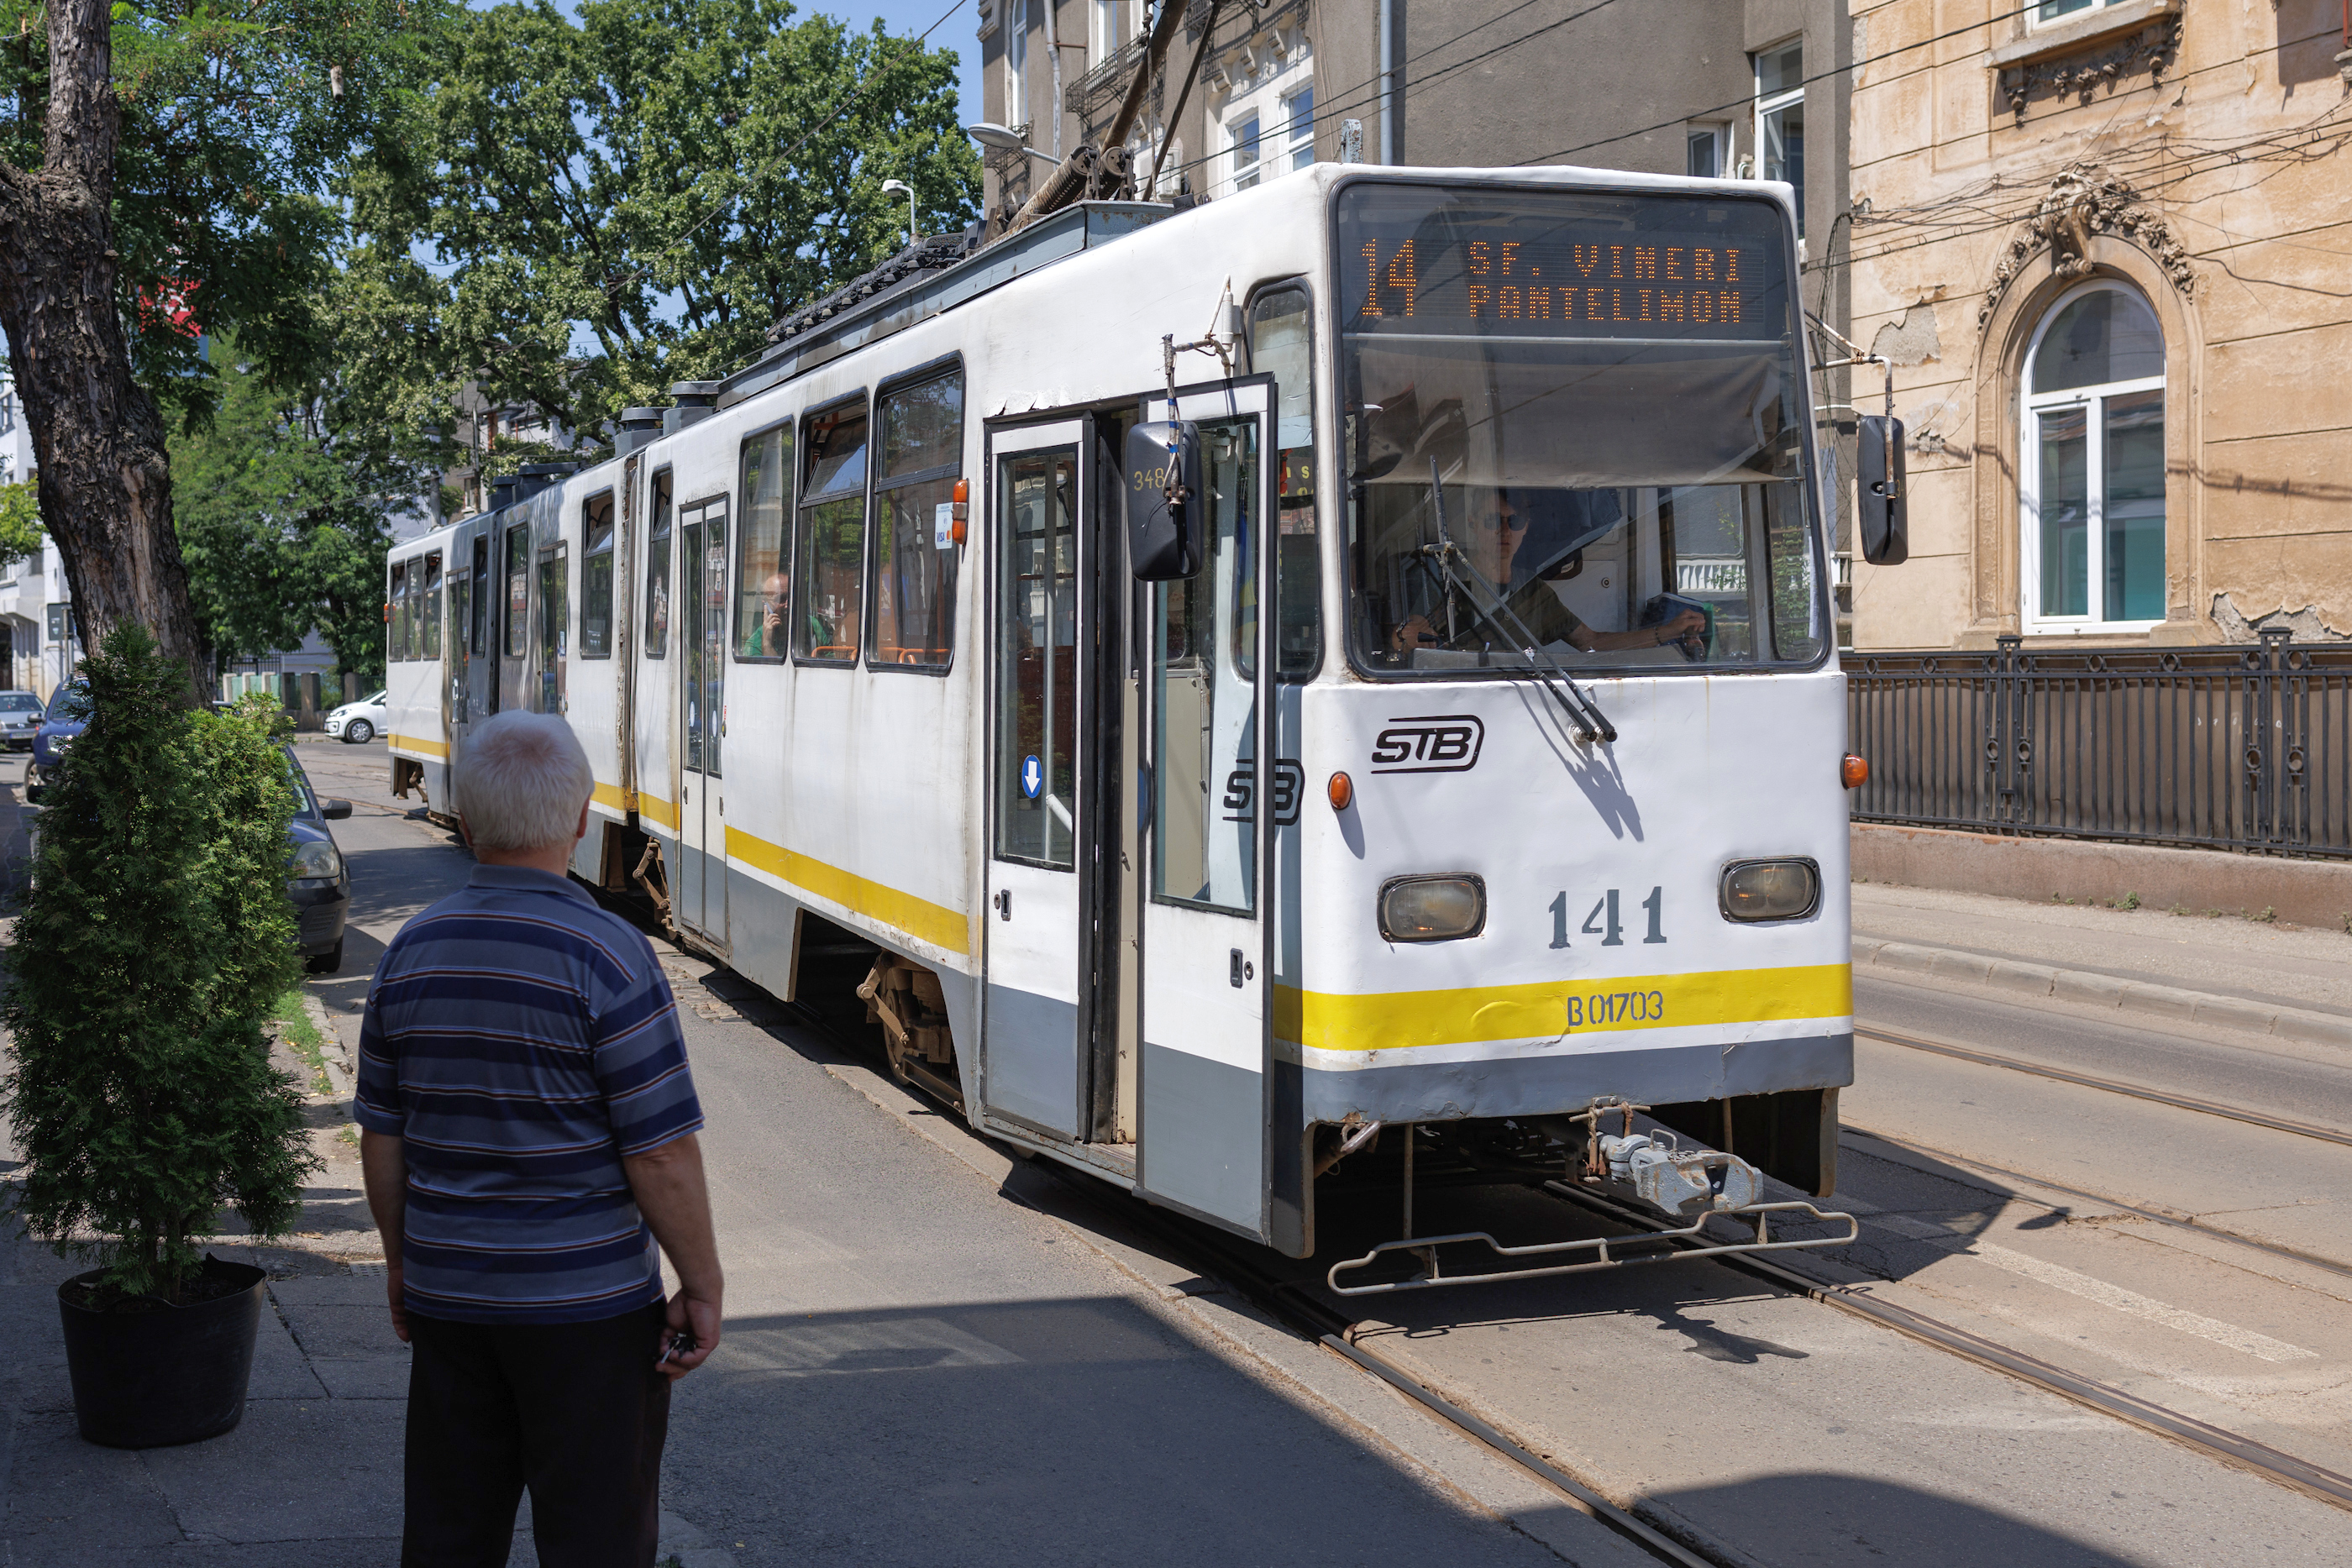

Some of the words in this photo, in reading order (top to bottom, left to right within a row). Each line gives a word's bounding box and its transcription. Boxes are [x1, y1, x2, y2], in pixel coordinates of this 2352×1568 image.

[1362, 238, 1417, 317] 14
[1469, 241, 1540, 276] SF.
[1574, 244, 1740, 281] VINERI
[1469, 284, 1740, 323] PANTELIMON
[1133, 467, 1165, 491] 348
[1371, 726, 1473, 763] STB
[1223, 769, 1296, 811] SB
[1548, 886, 1667, 950] 141
